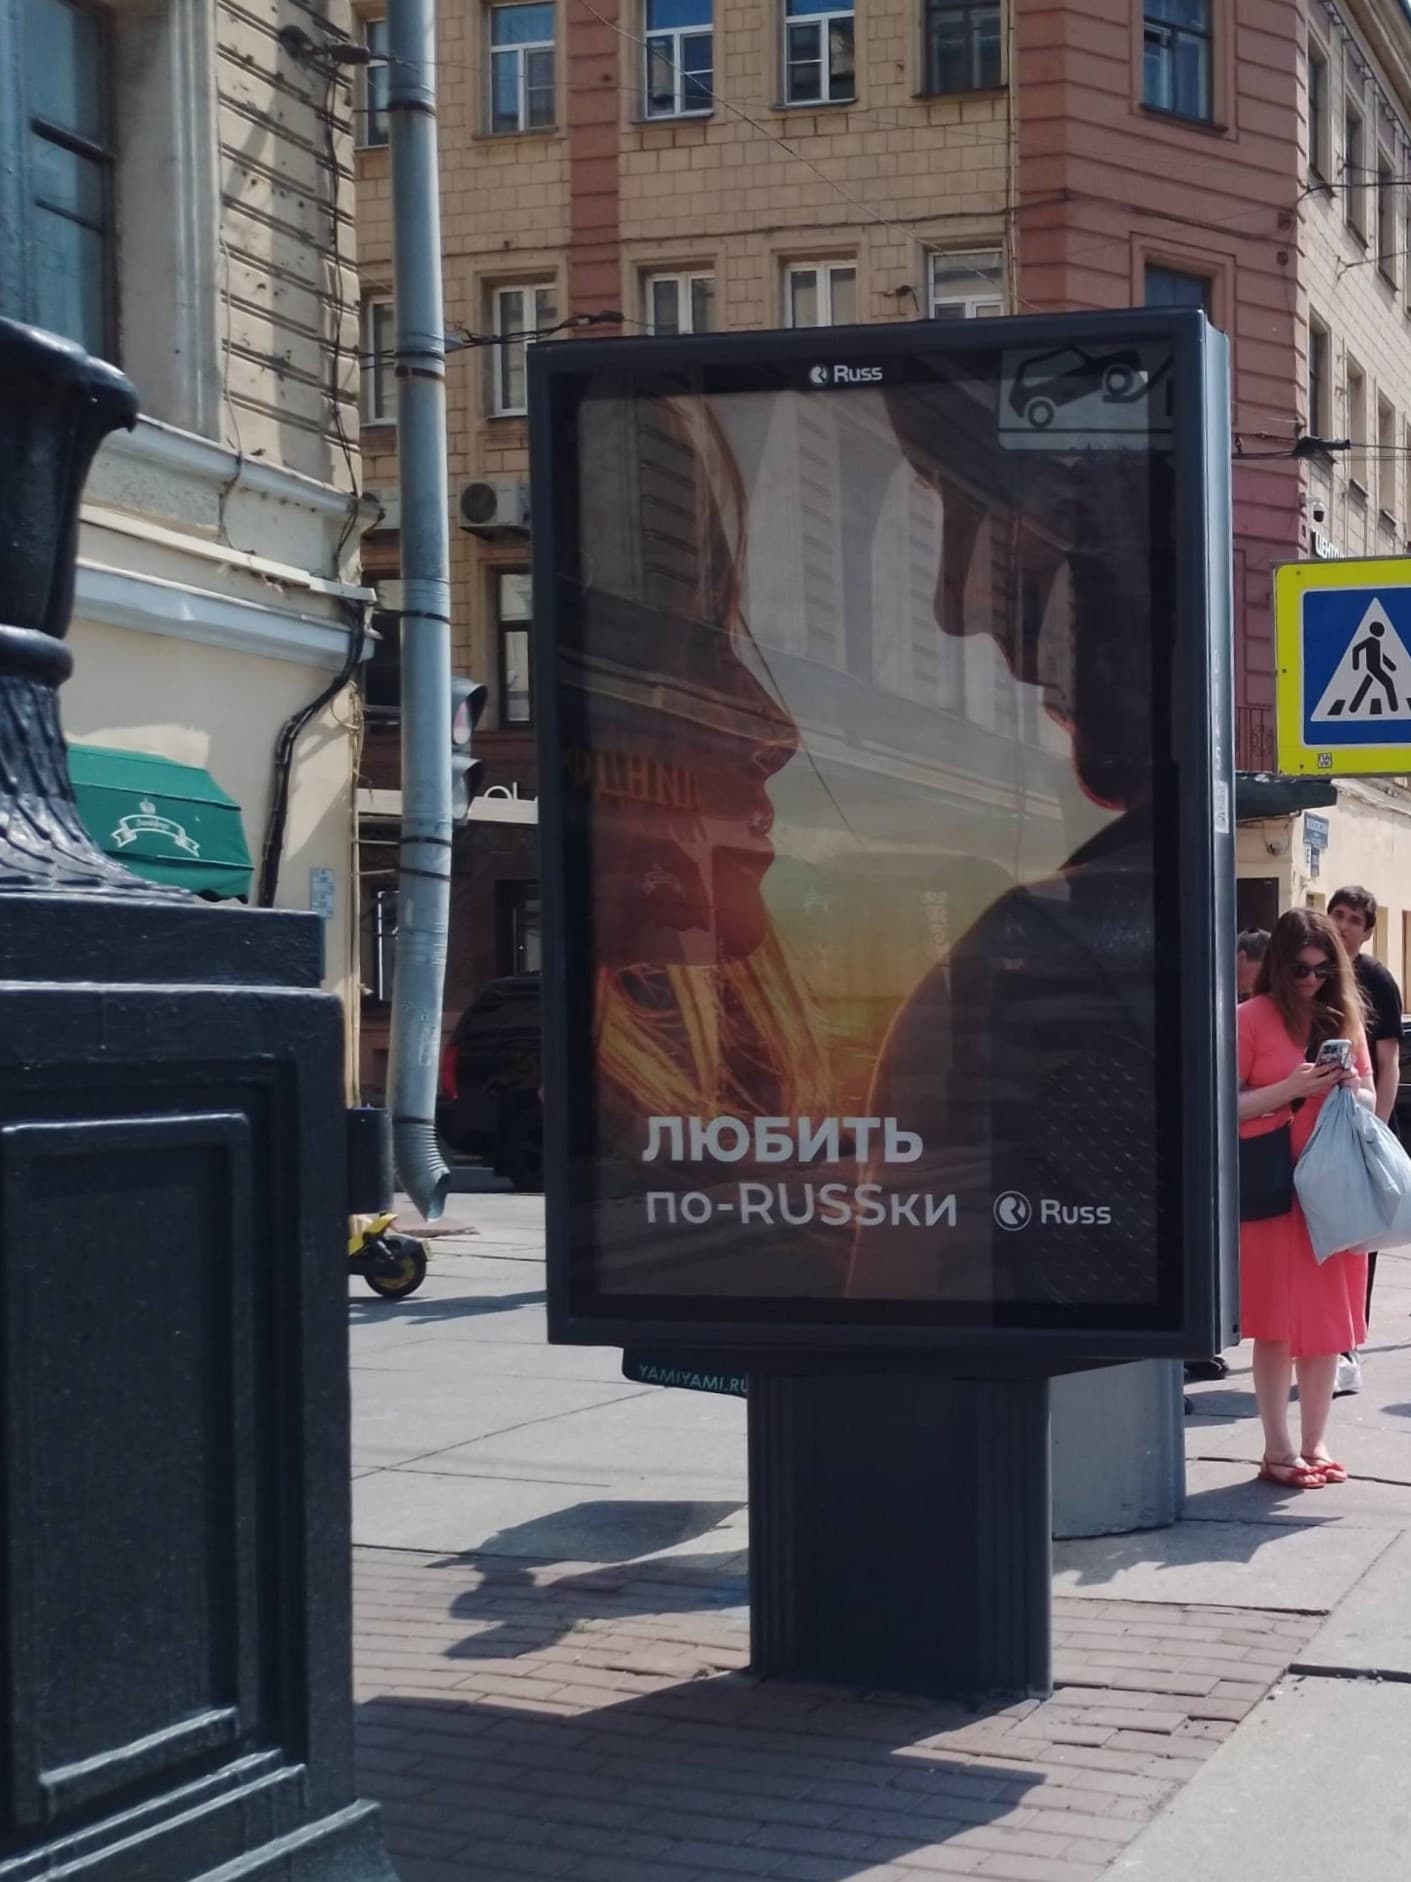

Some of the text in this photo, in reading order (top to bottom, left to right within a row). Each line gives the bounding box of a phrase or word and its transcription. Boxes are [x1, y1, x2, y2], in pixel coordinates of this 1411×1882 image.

[833, 364, 884, 383] Russ
[642, 1115, 924, 1163] ЛЮБИТЬ
[645, 1182, 957, 1228] по-RUSSки
[1040, 1199, 1112, 1225] Russ
[639, 1364, 748, 1393] YAMIYAMI.RU
